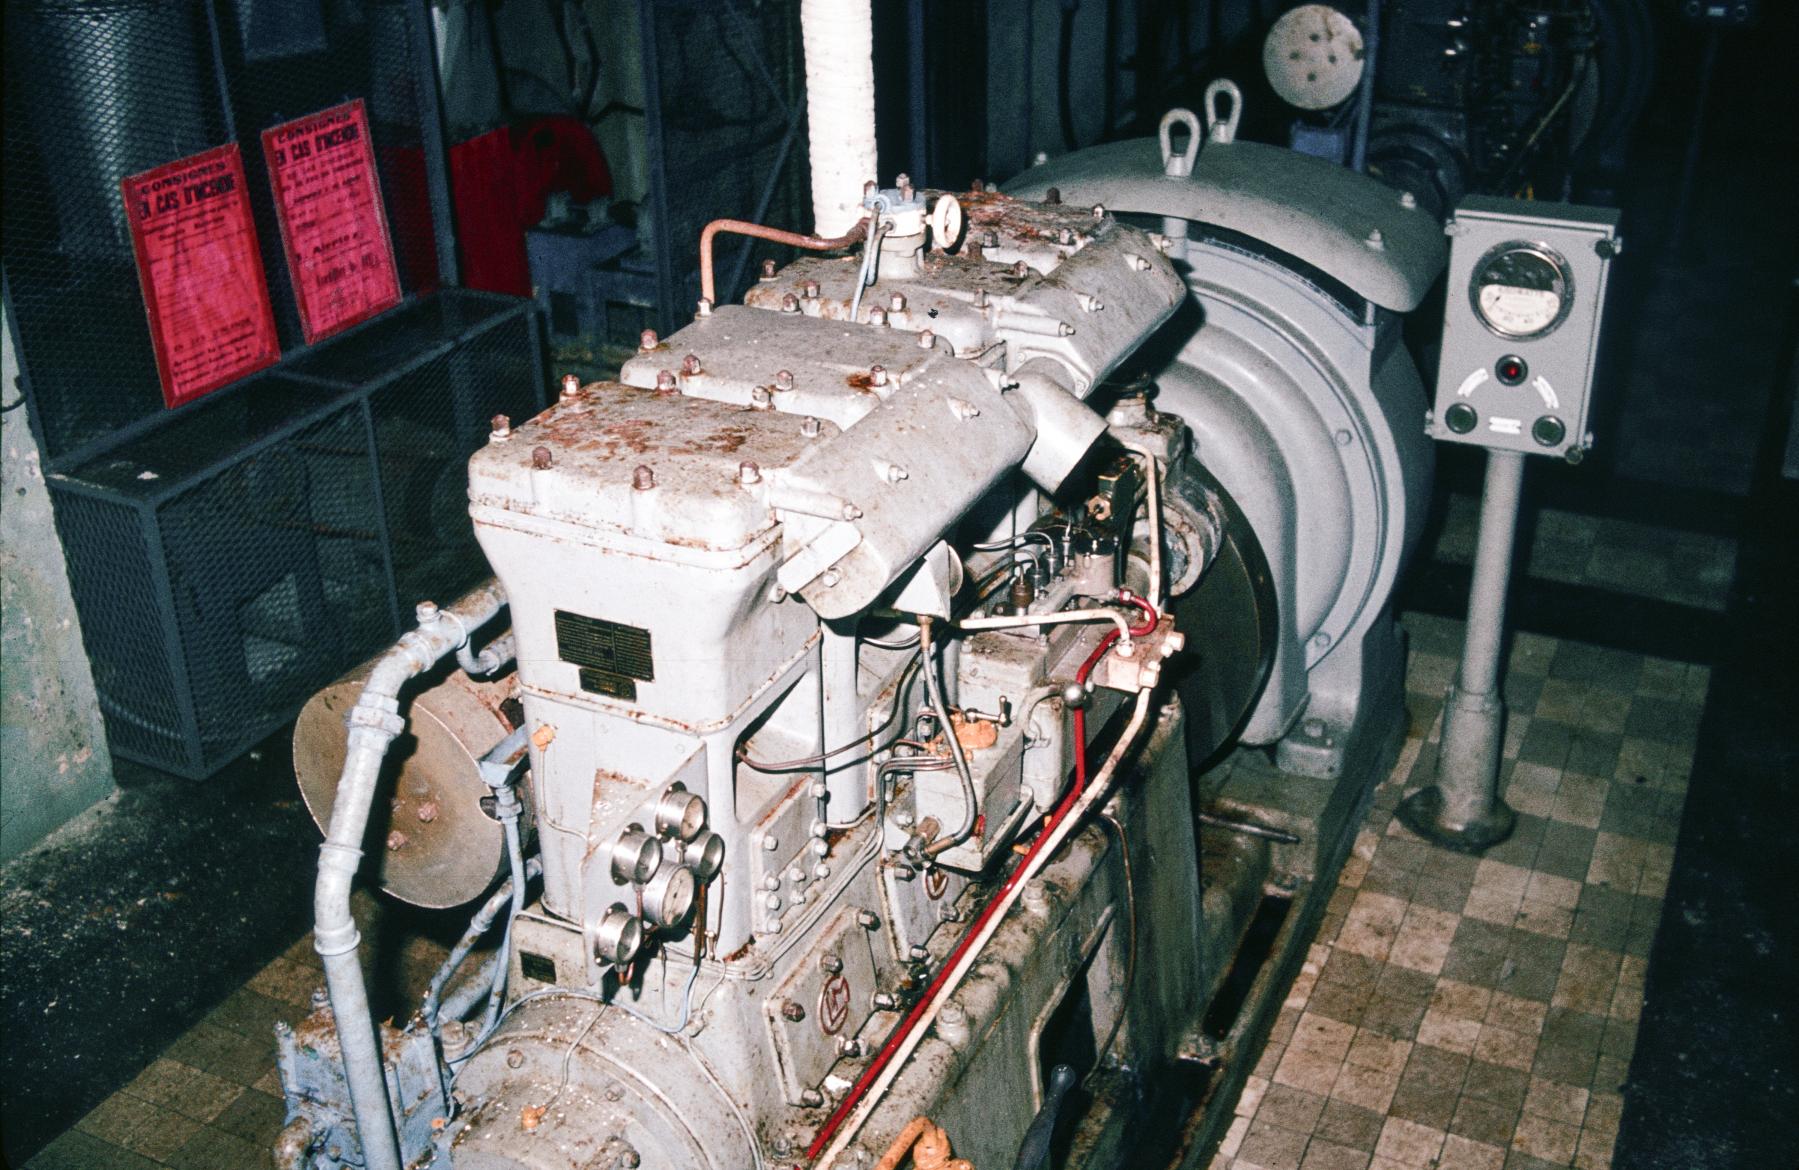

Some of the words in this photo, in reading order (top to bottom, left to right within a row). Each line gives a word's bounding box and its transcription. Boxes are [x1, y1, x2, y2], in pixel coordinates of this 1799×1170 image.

[278, 112, 351, 144] CONSIGNES
[290, 140, 312, 160] CAS
[315, 122, 359, 152] D'INCENDIE
[141, 161, 226, 195] CONSIGNES
[156, 190, 179, 214] CAS
[183, 172, 236, 206] D'INCENDIE
